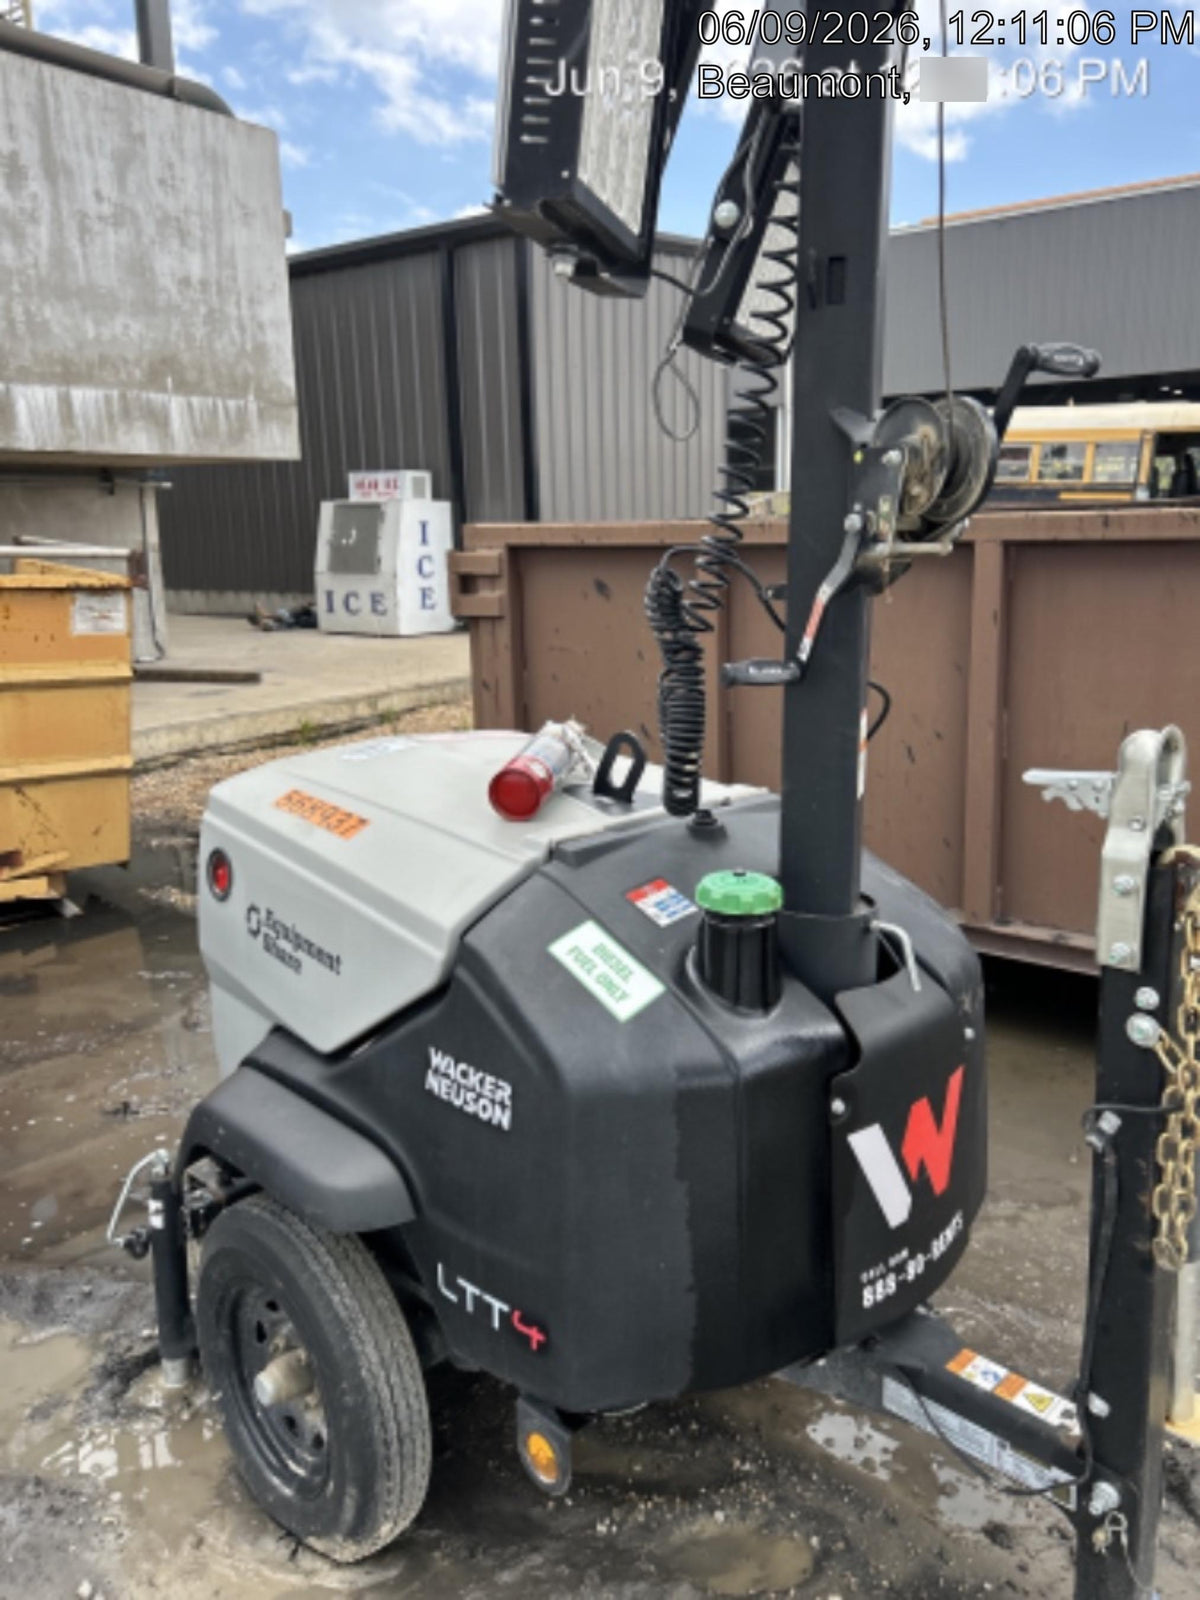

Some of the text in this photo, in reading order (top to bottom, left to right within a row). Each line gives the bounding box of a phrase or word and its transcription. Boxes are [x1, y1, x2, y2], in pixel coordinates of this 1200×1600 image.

[416, 520, 436, 610] ICE
[324, 590, 388, 616] ICE
[425, 1069, 512, 1131] NEUSON
[428, 1046, 512, 1105] WACKER
[437, 1262, 546, 1351] LTT4
